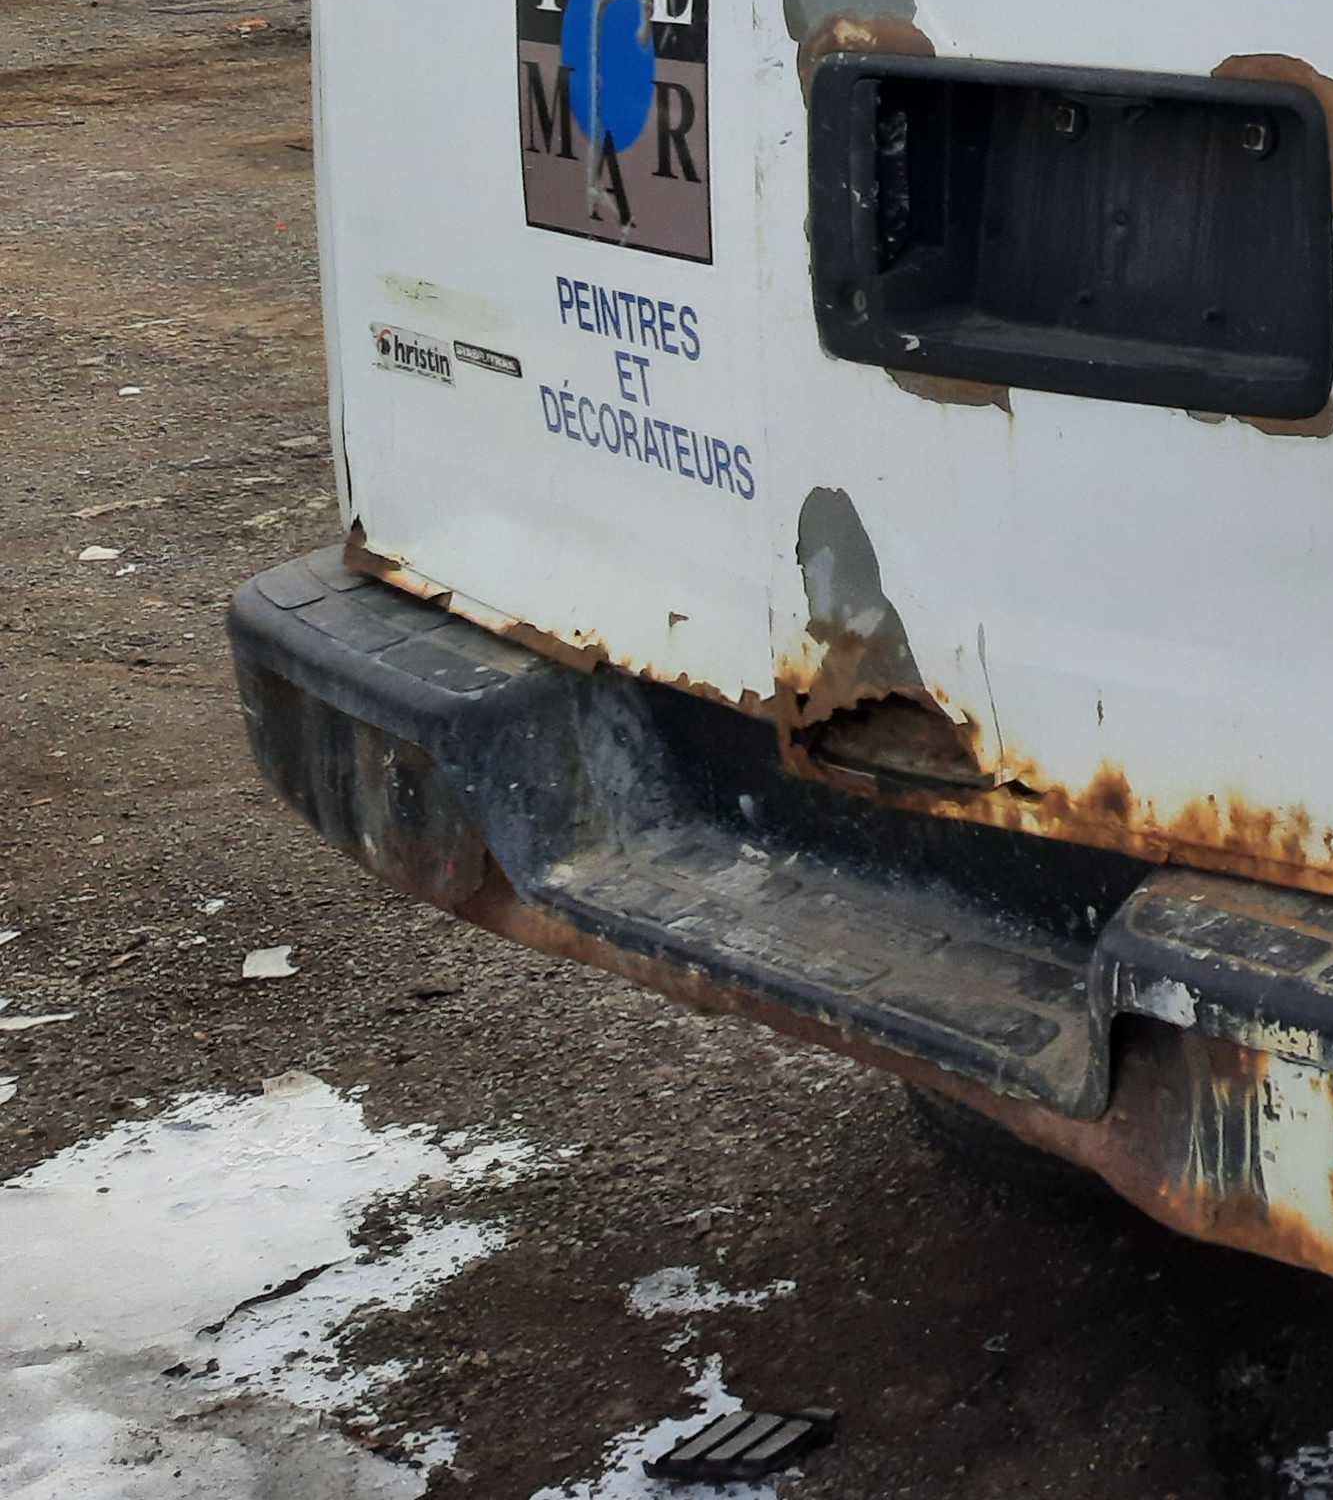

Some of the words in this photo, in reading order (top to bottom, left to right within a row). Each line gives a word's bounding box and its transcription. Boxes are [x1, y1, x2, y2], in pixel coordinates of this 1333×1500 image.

[557, 276, 701, 361] PEINTRES
[618, 350, 650, 407] ET
[539, 379, 756, 501] DÉCORATEURS
